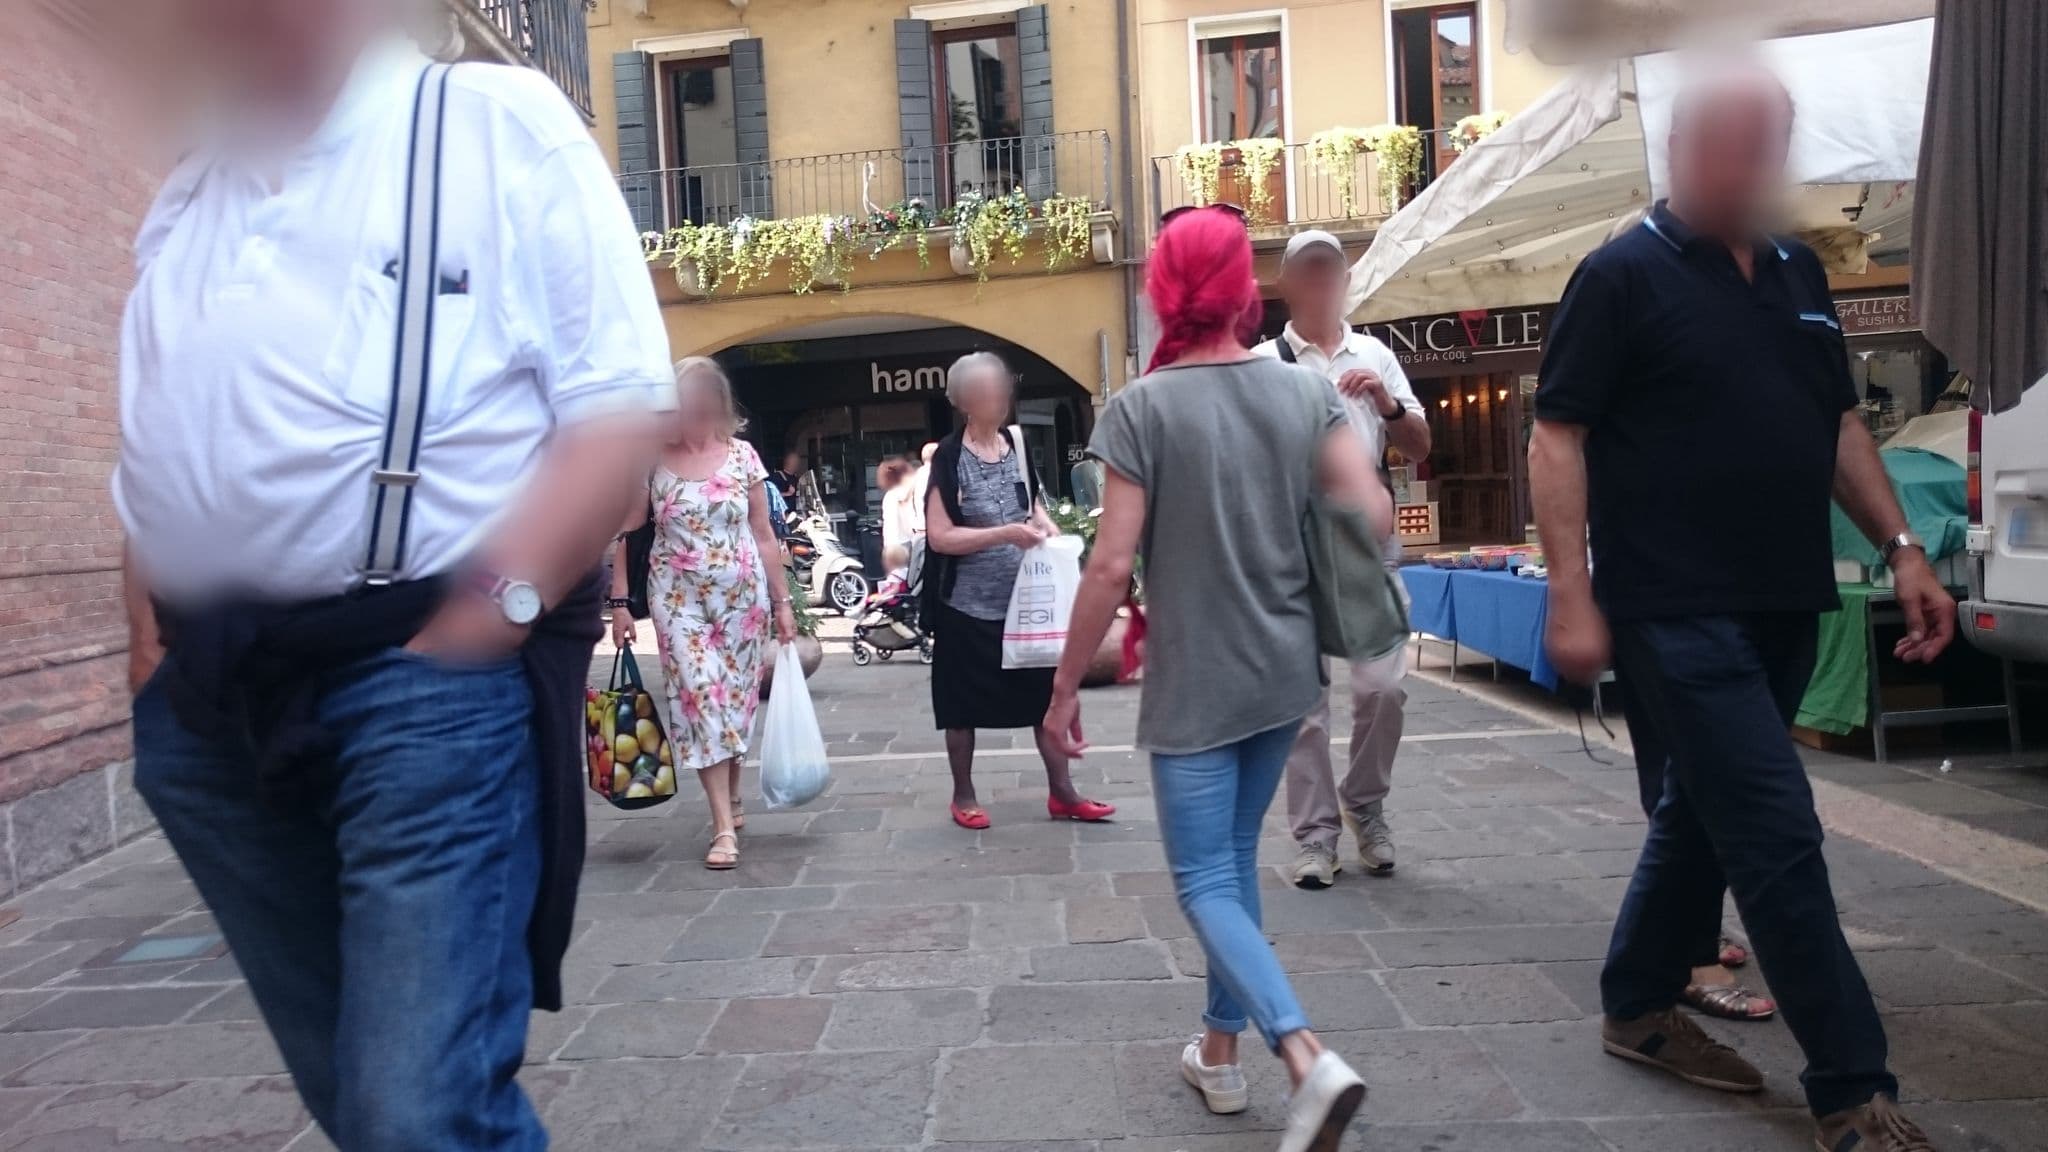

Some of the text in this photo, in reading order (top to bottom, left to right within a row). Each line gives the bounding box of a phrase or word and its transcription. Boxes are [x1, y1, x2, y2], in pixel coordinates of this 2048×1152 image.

[1835, 300, 1911, 318] GALLER
[1857, 314, 1906, 327] SUSHI &
[1413, 354, 1422, 363] SI
[1425, 353, 1439, 362] FA
[1442, 350, 1467, 361] COOL
